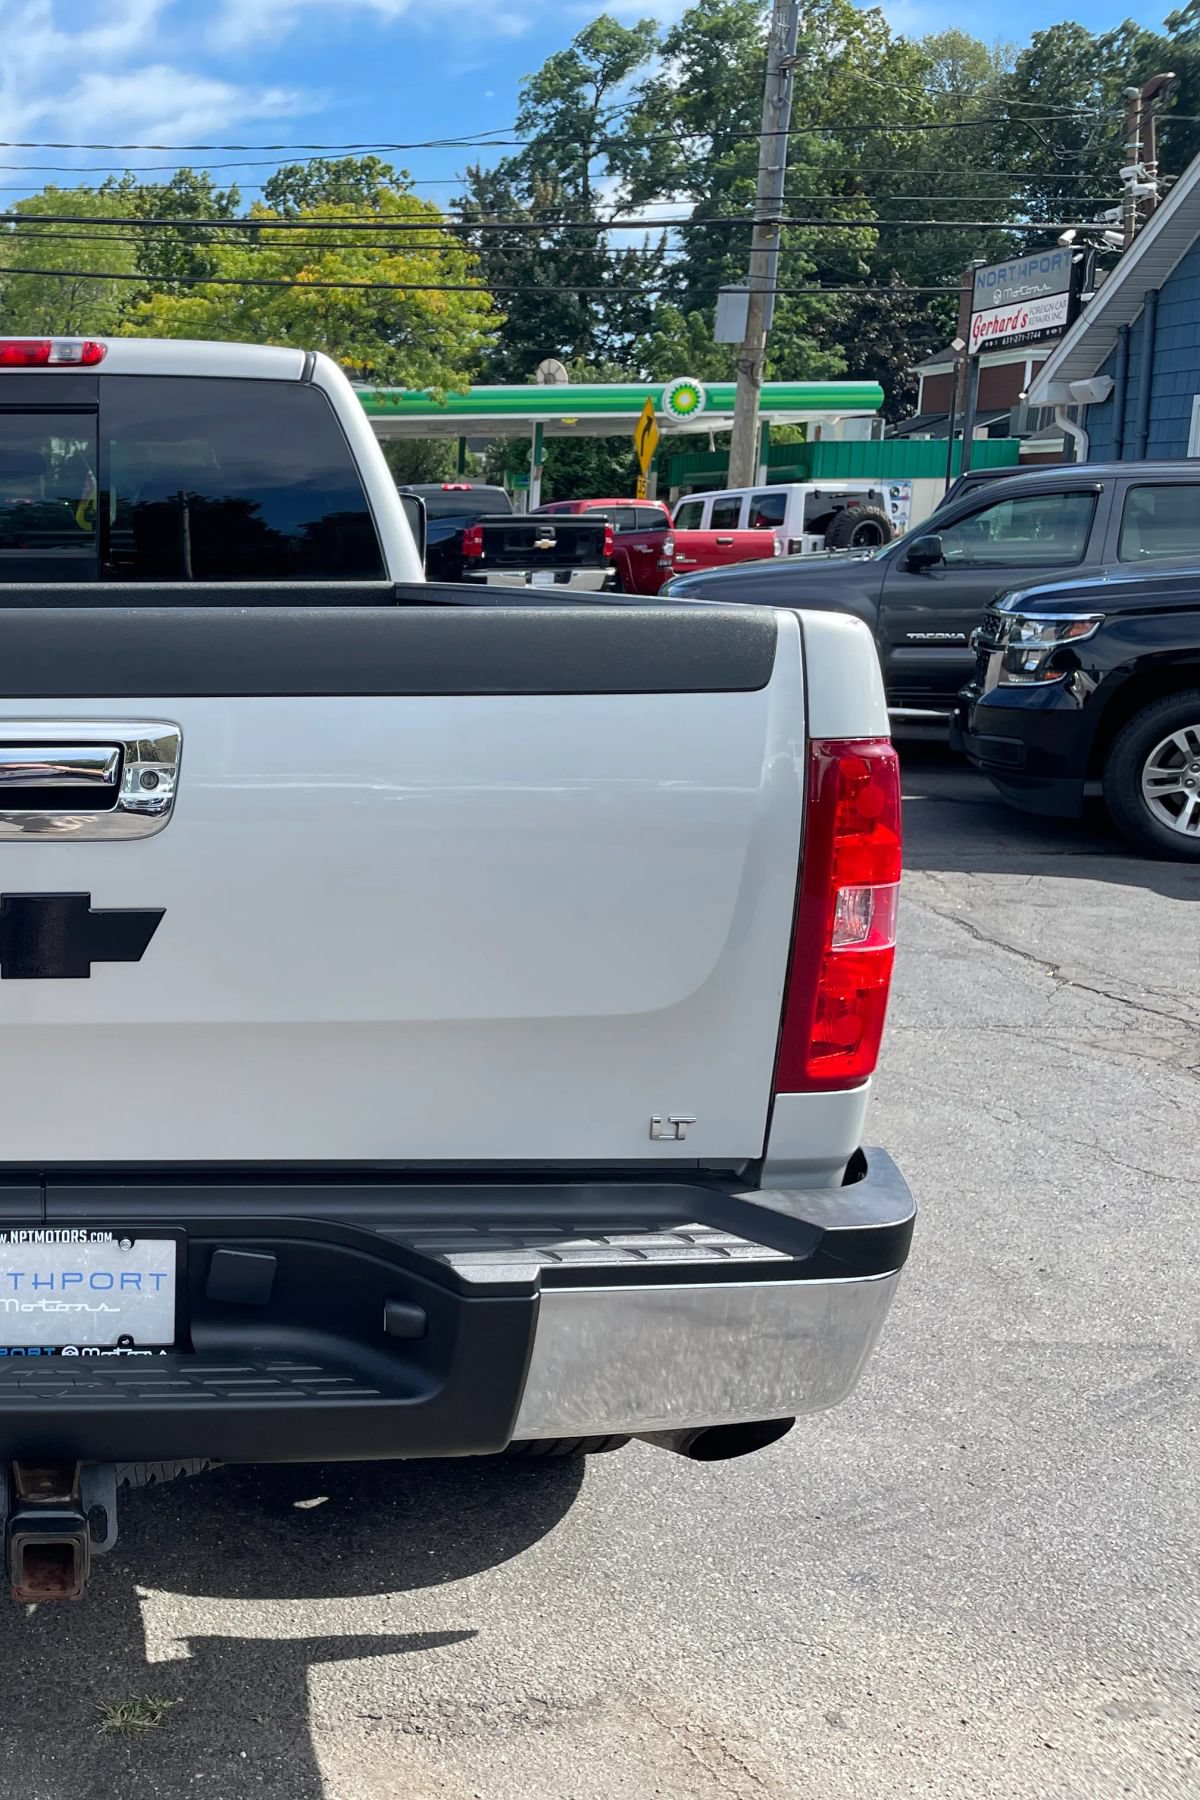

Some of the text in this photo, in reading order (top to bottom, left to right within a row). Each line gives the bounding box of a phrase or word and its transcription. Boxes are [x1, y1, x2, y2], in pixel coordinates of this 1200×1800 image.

[976, 251, 1072, 289] NORTHPORT
[972, 307, 1029, 346] Gerhard's
[906, 632, 966, 640] TACOMA
[649, 1116, 697, 1141] LT
